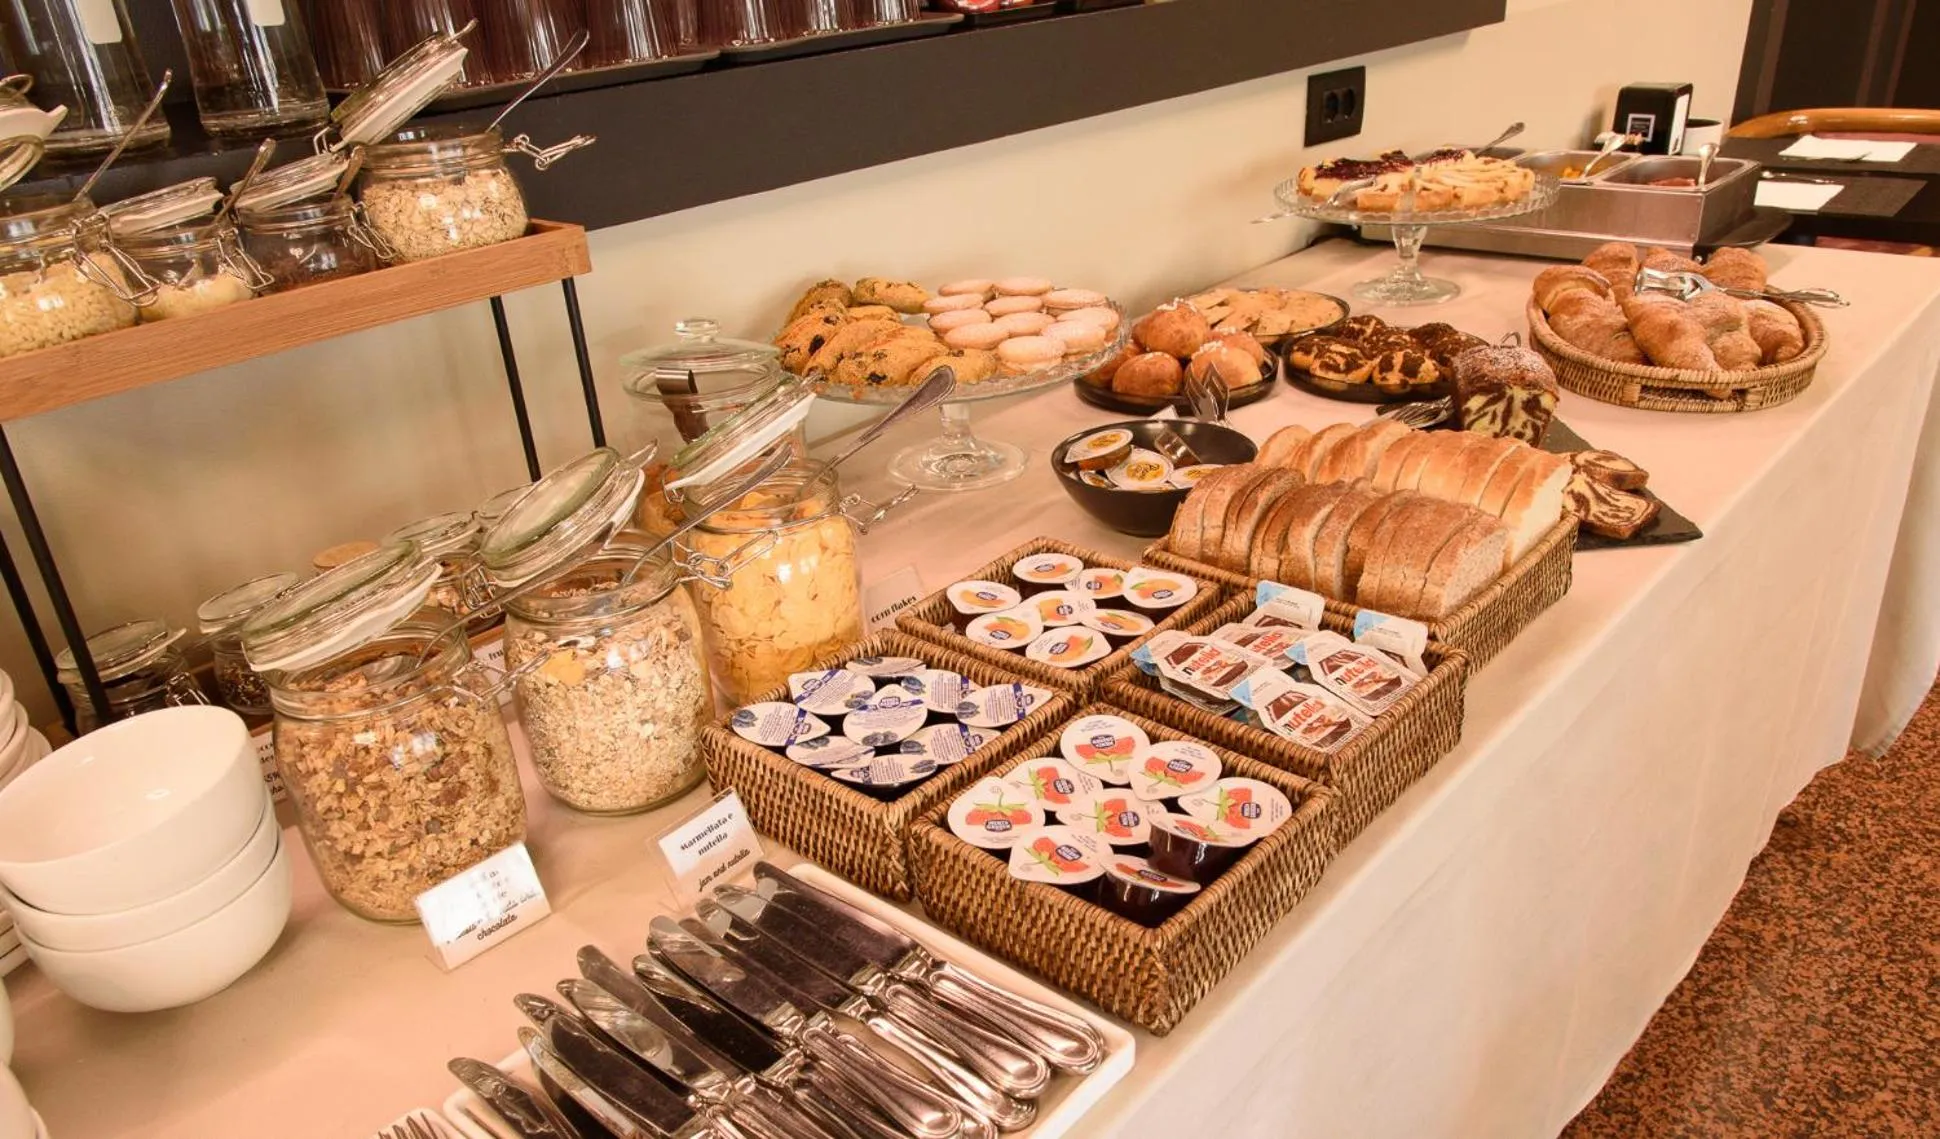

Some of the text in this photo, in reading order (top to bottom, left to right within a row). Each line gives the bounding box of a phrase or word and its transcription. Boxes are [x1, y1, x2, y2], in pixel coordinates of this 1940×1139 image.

[1283, 699, 1326, 734] nutella
[698, 832, 728, 856] nutella
[477, 913, 517, 940] chocolate
